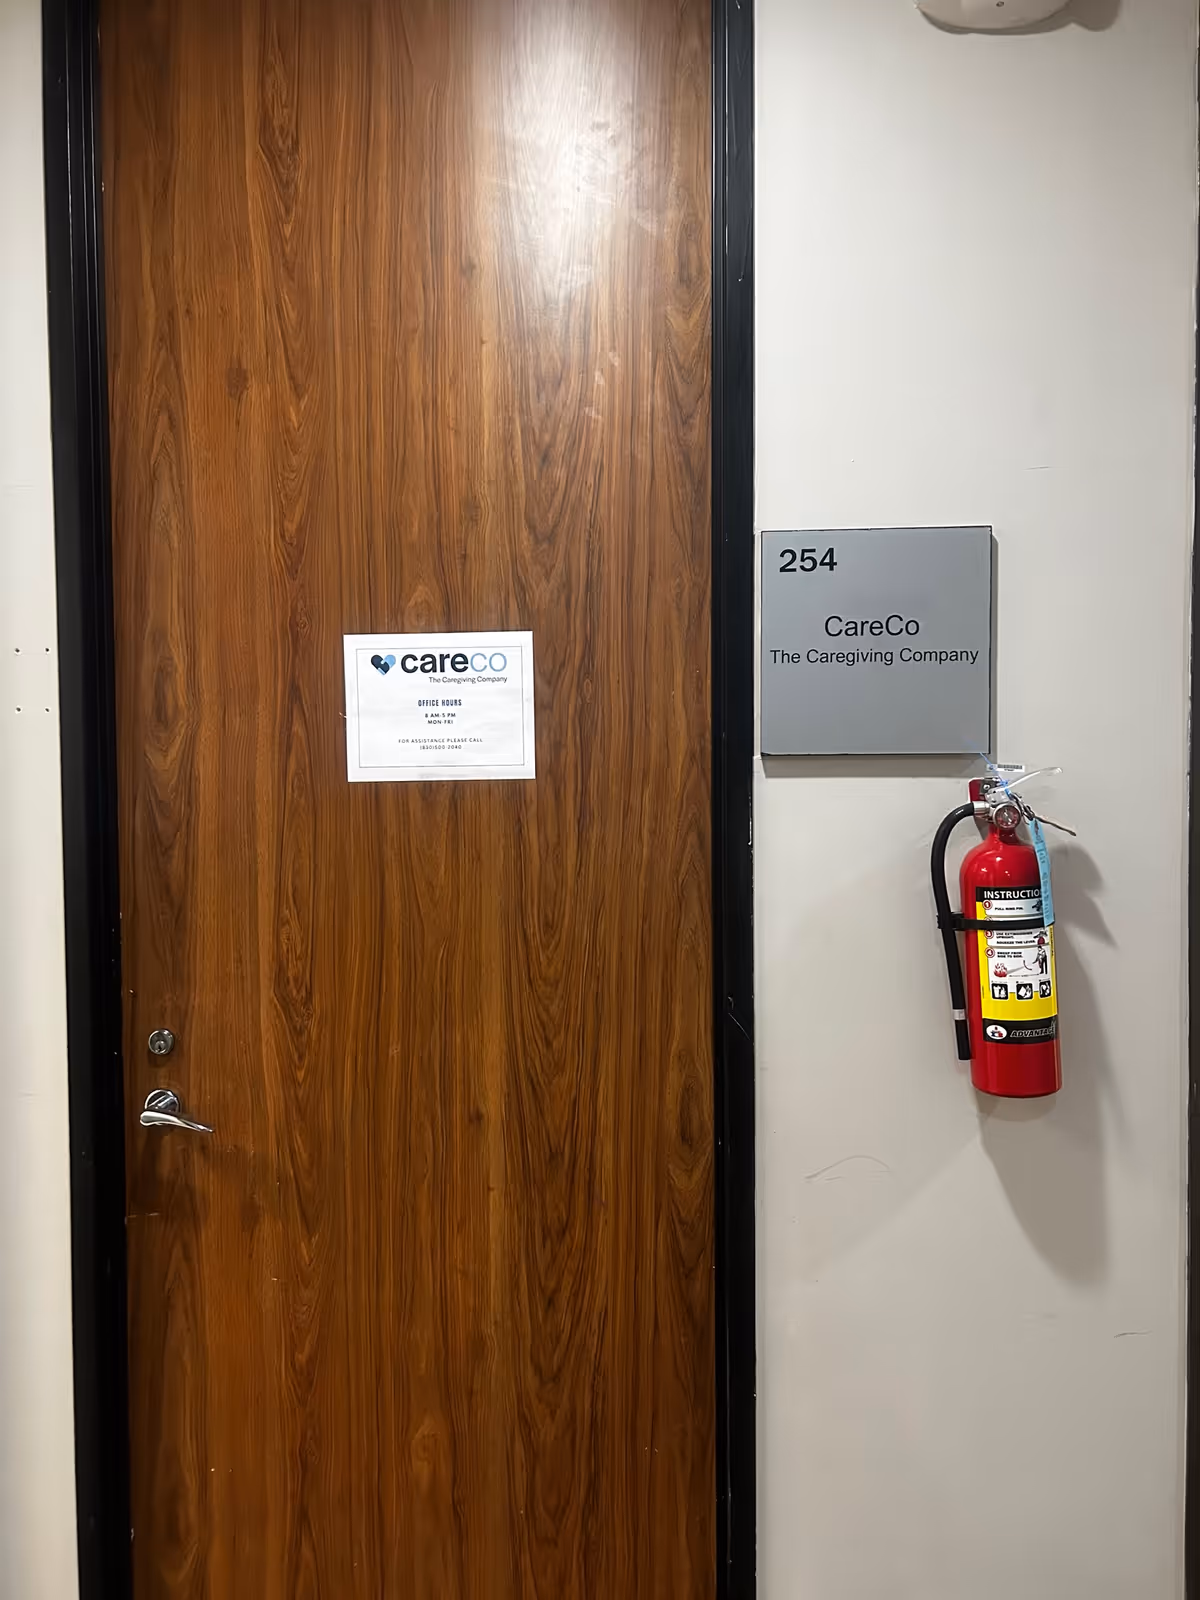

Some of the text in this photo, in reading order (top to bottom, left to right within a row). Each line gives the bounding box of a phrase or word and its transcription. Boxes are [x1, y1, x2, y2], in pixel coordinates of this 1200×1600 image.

[779, 547, 838, 573] 254
[824, 614, 920, 637] CareCo
[400, 652, 508, 674] careco
[770, 647, 979, 667] The Caregiving Company
[428, 675, 508, 685] The Caregiving Company
[417, 699, 462, 707] OFFICE HOURS
[984, 889, 1041, 899] INSTRUCTIO
